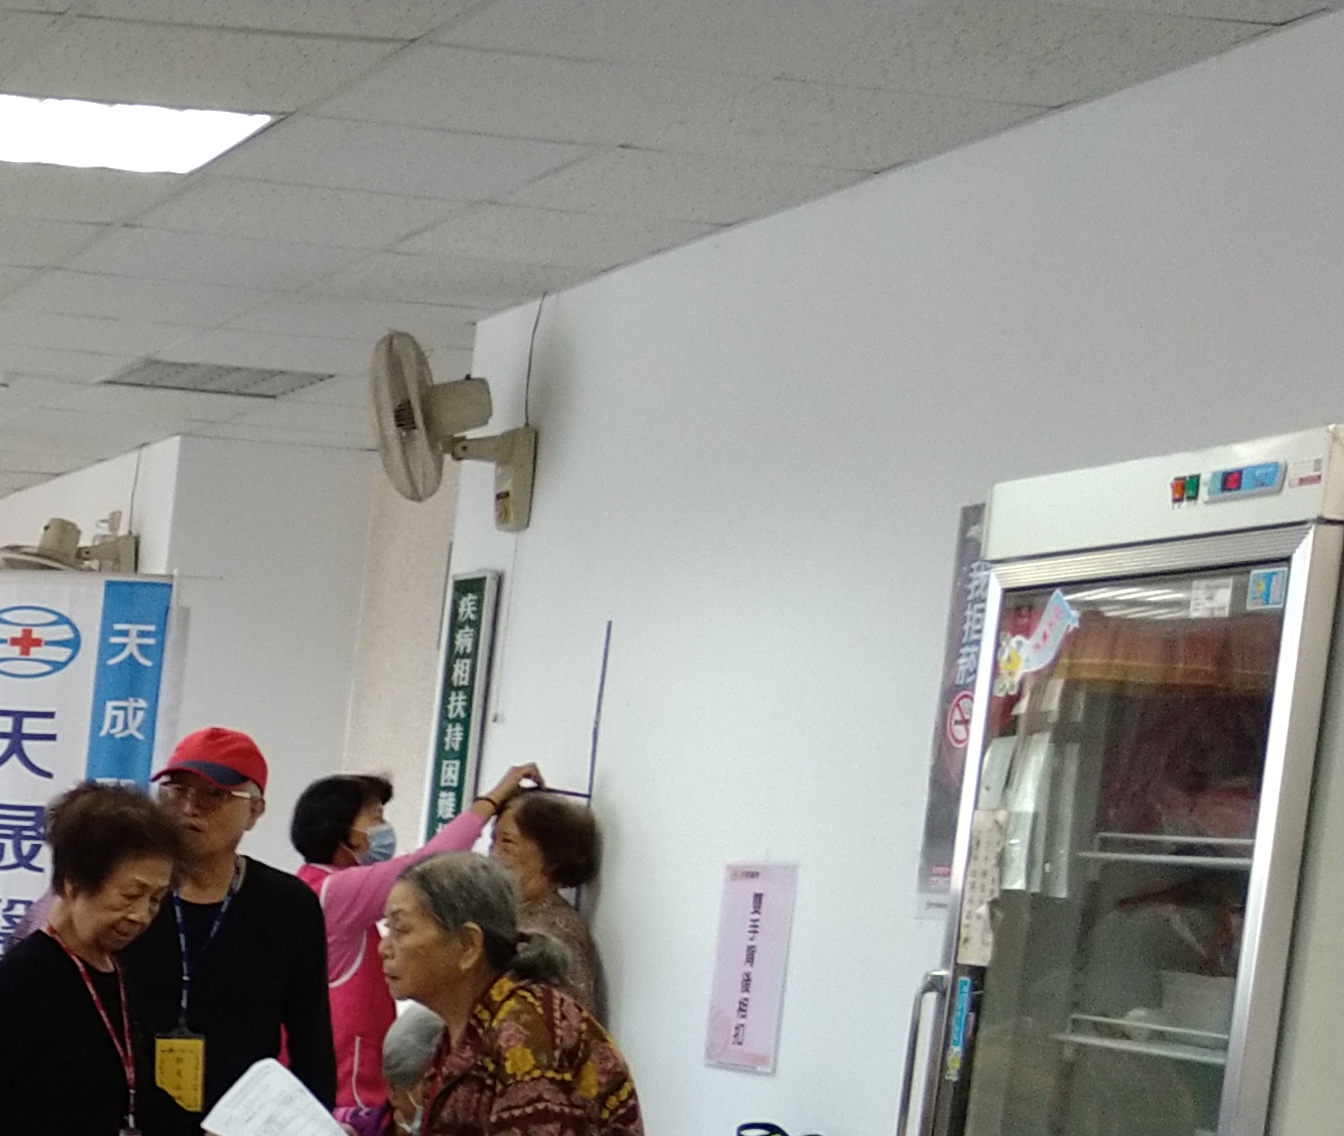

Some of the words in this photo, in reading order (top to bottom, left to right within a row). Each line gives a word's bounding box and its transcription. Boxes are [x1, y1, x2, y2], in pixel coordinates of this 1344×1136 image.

[99, 623, 156, 785] 天成
[435, 592, 479, 833] 疾病相扶持困難
